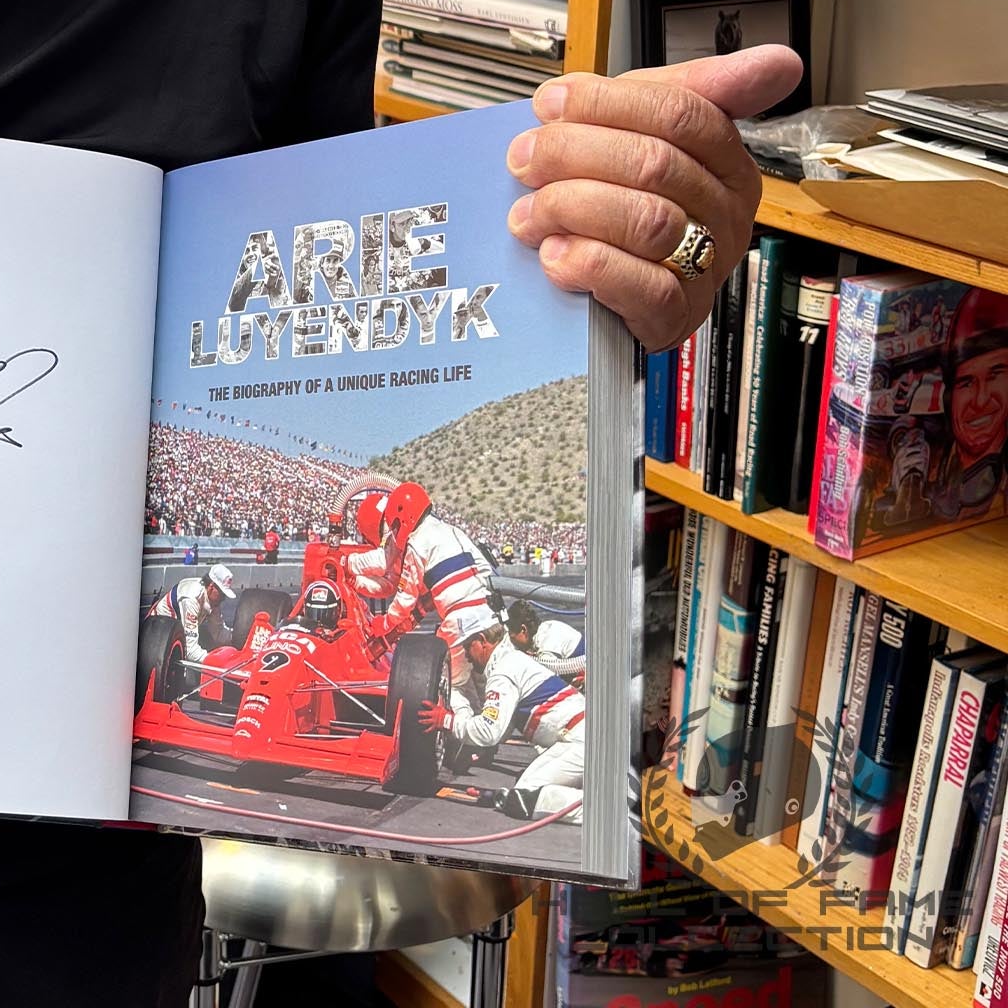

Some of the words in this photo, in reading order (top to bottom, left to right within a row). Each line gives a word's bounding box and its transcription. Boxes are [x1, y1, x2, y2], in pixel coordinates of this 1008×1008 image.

[223, 201, 450, 315] ARIE
[758, 258, 770, 283] Road
[189, 283, 501, 369] LUYENDYK
[799, 326, 820, 344] 11
[752, 325, 764, 375] Celebrating
[209, 387, 230, 402] THE
[232, 380, 301, 399] BIOGRAPHY
[305, 378, 323, 394] OF
[324, 378, 334, 392] A
[337, 373, 386, 391] UNIQUE
[390, 368, 440, 387] RACING
[443, 365, 472, 382] LIFE
[679, 370, 692, 412] Banks
[751, 376, 761, 388] 50
[749, 389, 759, 412] Years
[749, 414, 758, 423] of
[747, 424, 757, 446] Road
[839, 426, 850, 448] Bob
[744, 447, 756, 477] Racing
[833, 449, 848, 501] Schilling
[758, 586, 775, 645] FAMILIES
[880, 613, 906, 649] 500
[258, 650, 291, 672] 9
[850, 620, 877, 695] MANSELL'S
[848, 697, 862, 723] Indy
[884, 690, 894, 707] Great
[920, 670, 946, 749] Indianapolis
[880, 708, 892, 735] American
[875, 735, 887, 763] Tradition
[943, 690, 980, 789] CHAPARRAL
[909, 749, 930, 813] Roadsters
[997, 947, 1008, 974] INDY
[993, 975, 1004, 1000] 500
